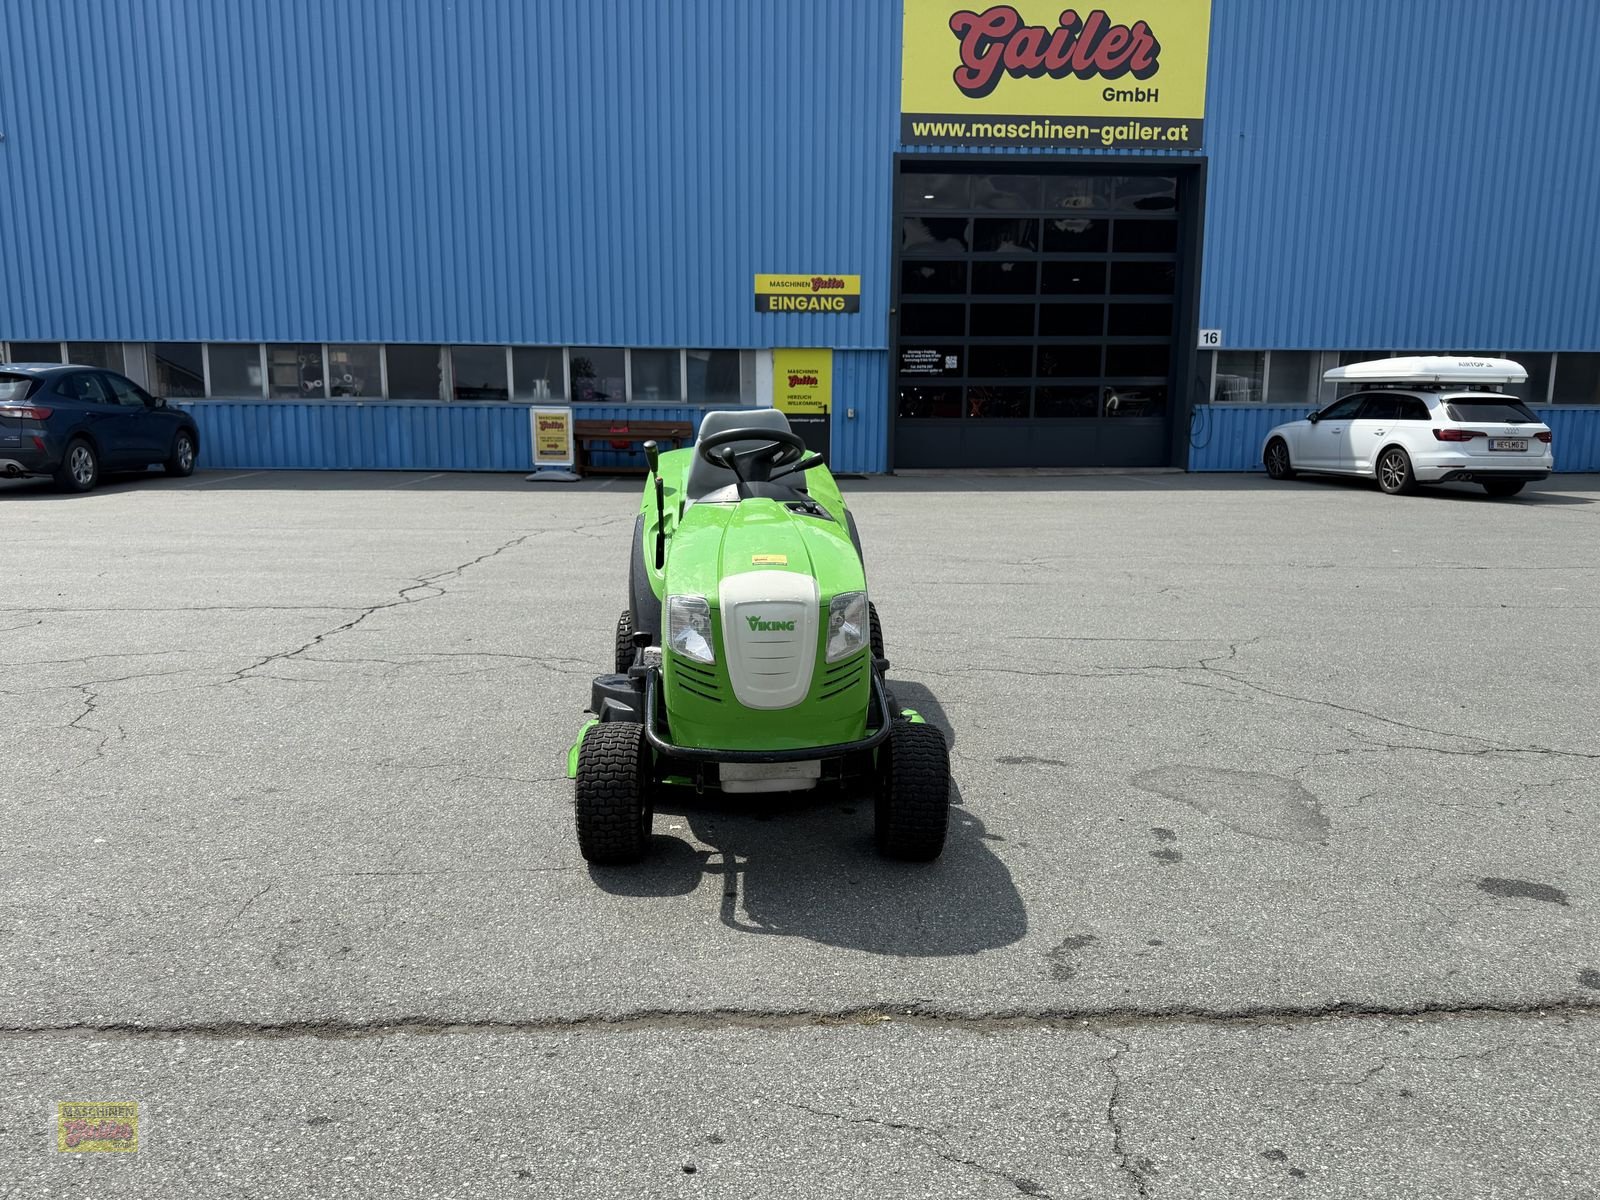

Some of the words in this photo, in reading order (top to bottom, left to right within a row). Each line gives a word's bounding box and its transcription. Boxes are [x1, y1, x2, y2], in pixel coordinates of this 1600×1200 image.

[949, 5, 1161, 99] Gailer
[1102, 87, 1159, 103] GmbH
[912, 119, 1189, 146] www.maschinen-gailer.at
[769, 296, 845, 310] EINGANG
[1203, 332, 1218, 344] 16
[746, 617, 796, 632] VIKING
